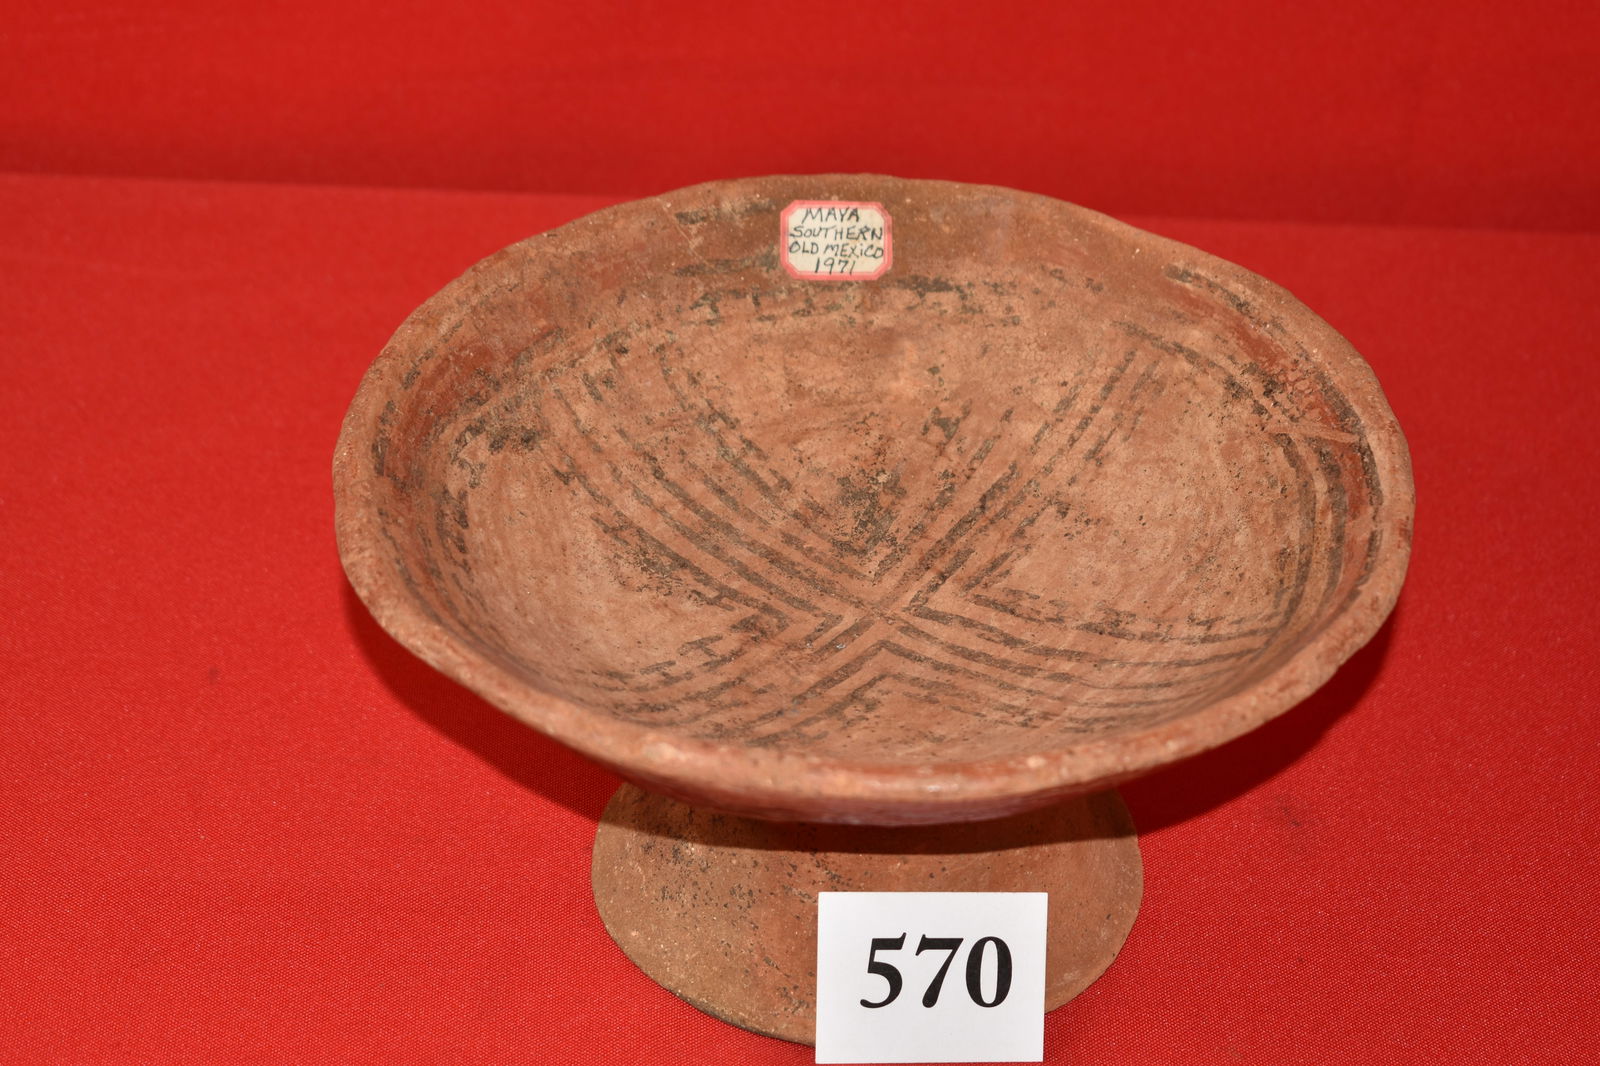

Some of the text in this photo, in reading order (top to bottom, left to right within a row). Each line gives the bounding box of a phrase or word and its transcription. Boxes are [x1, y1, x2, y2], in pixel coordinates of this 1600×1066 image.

[801, 207, 860, 224] MAYA
[789, 225, 883, 241] SOUTHERN
[789, 241, 819, 255] OLD
[814, 258, 856, 275] 1971
[859, 932, 1013, 1009] 570
